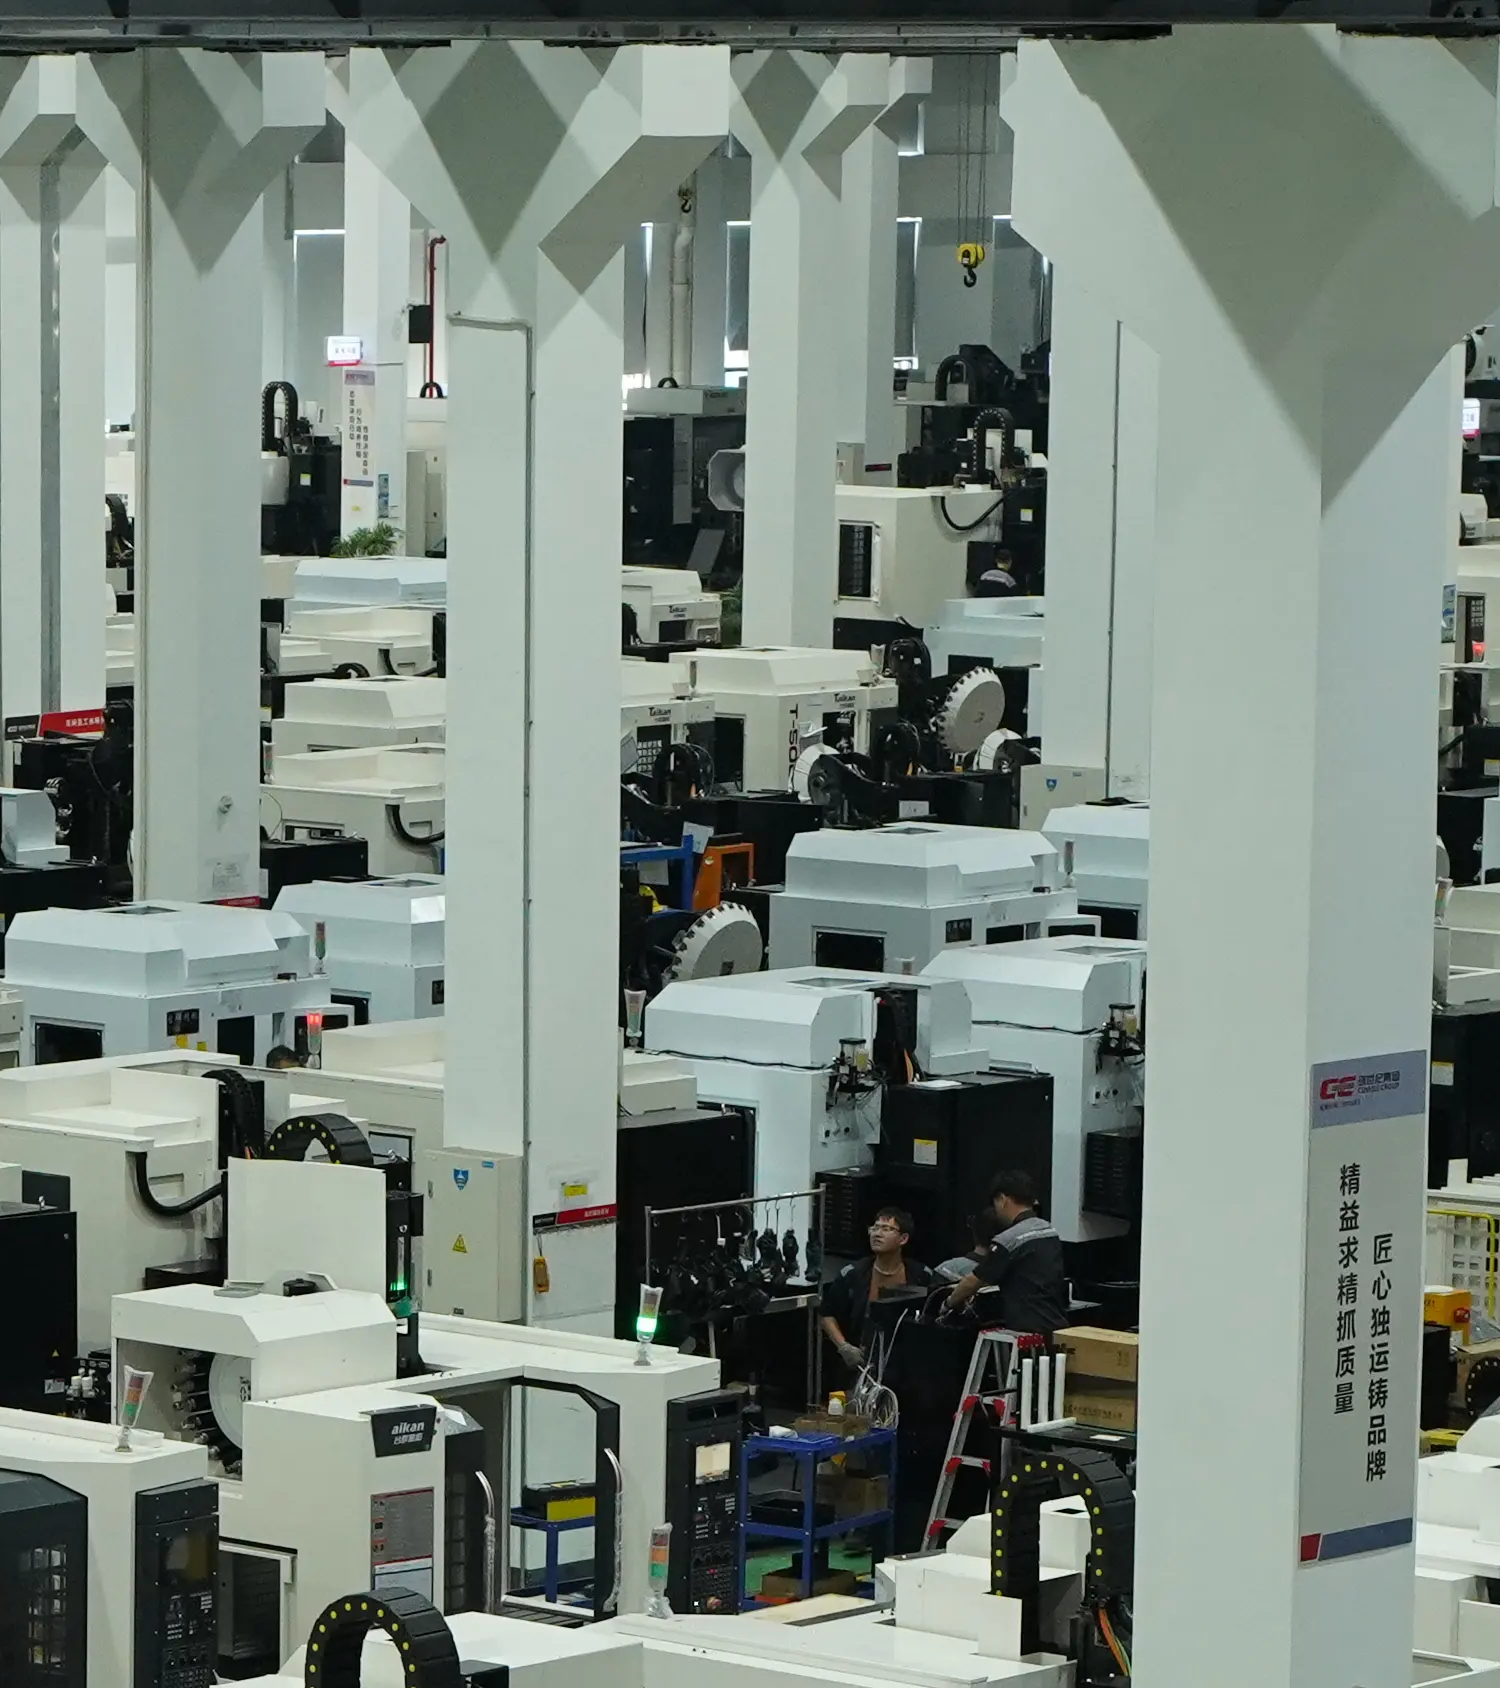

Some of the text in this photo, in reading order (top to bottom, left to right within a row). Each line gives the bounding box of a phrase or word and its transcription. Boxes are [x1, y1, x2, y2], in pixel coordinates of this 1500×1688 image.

[1333, 1162, 1361, 1416] 精益求精抓质量
[1366, 1232, 1393, 1482] 匠心独运铸品牌
